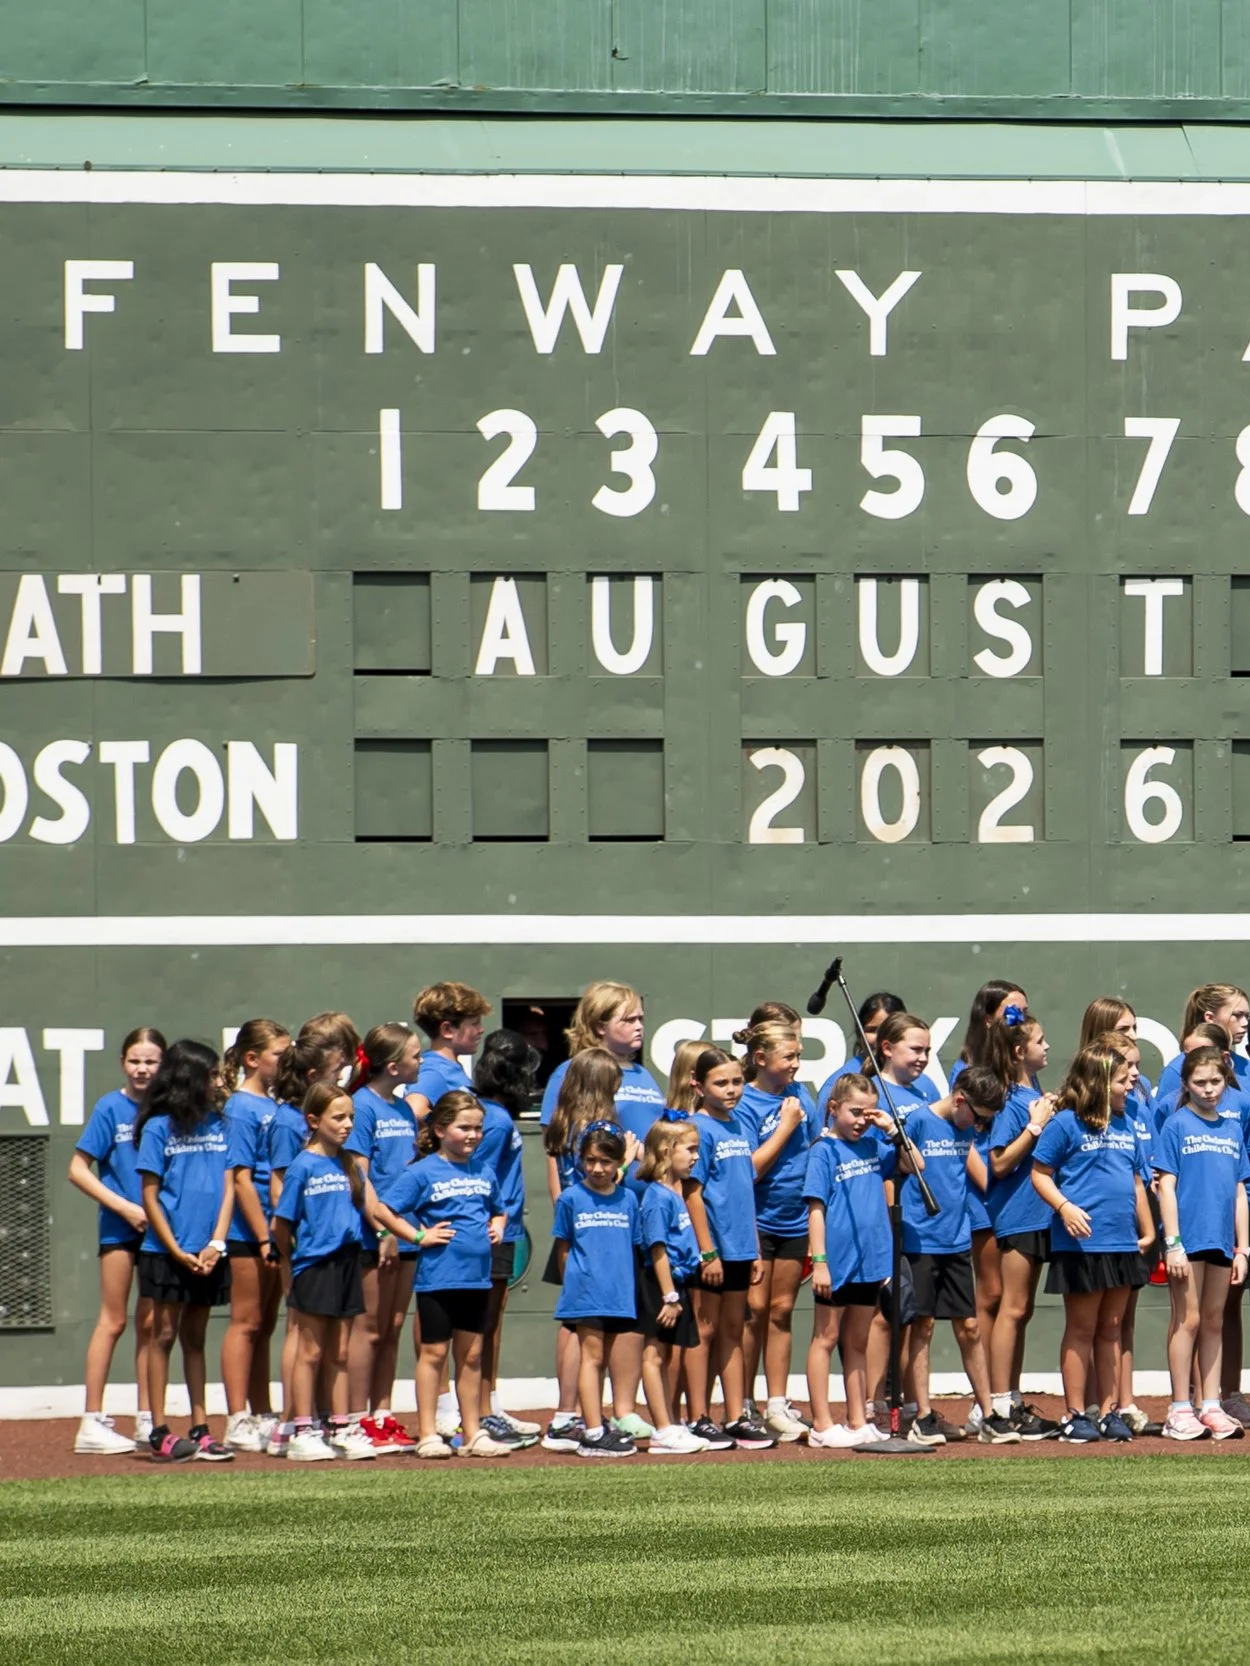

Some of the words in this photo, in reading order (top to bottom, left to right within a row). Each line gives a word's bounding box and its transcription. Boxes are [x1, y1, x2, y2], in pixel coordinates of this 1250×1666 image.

[65, 260, 922, 356] FENWAY
[380, 408, 402, 510] 1
[476, 409, 537, 511] 2
[592, 408, 658, 517] 3
[742, 412, 812, 512] 4
[860, 414, 924, 520] 5
[967, 413, 1037, 520] 6
[1125, 416, 1181, 515] 7
[0, 574, 202, 675] ATH
[749, 746, 1183, 845] 2026
[926, 1140, 941, 1150] The
[1182, 1144, 1221, 1155] Children's
[1184, 1135, 1201, 1145] The
